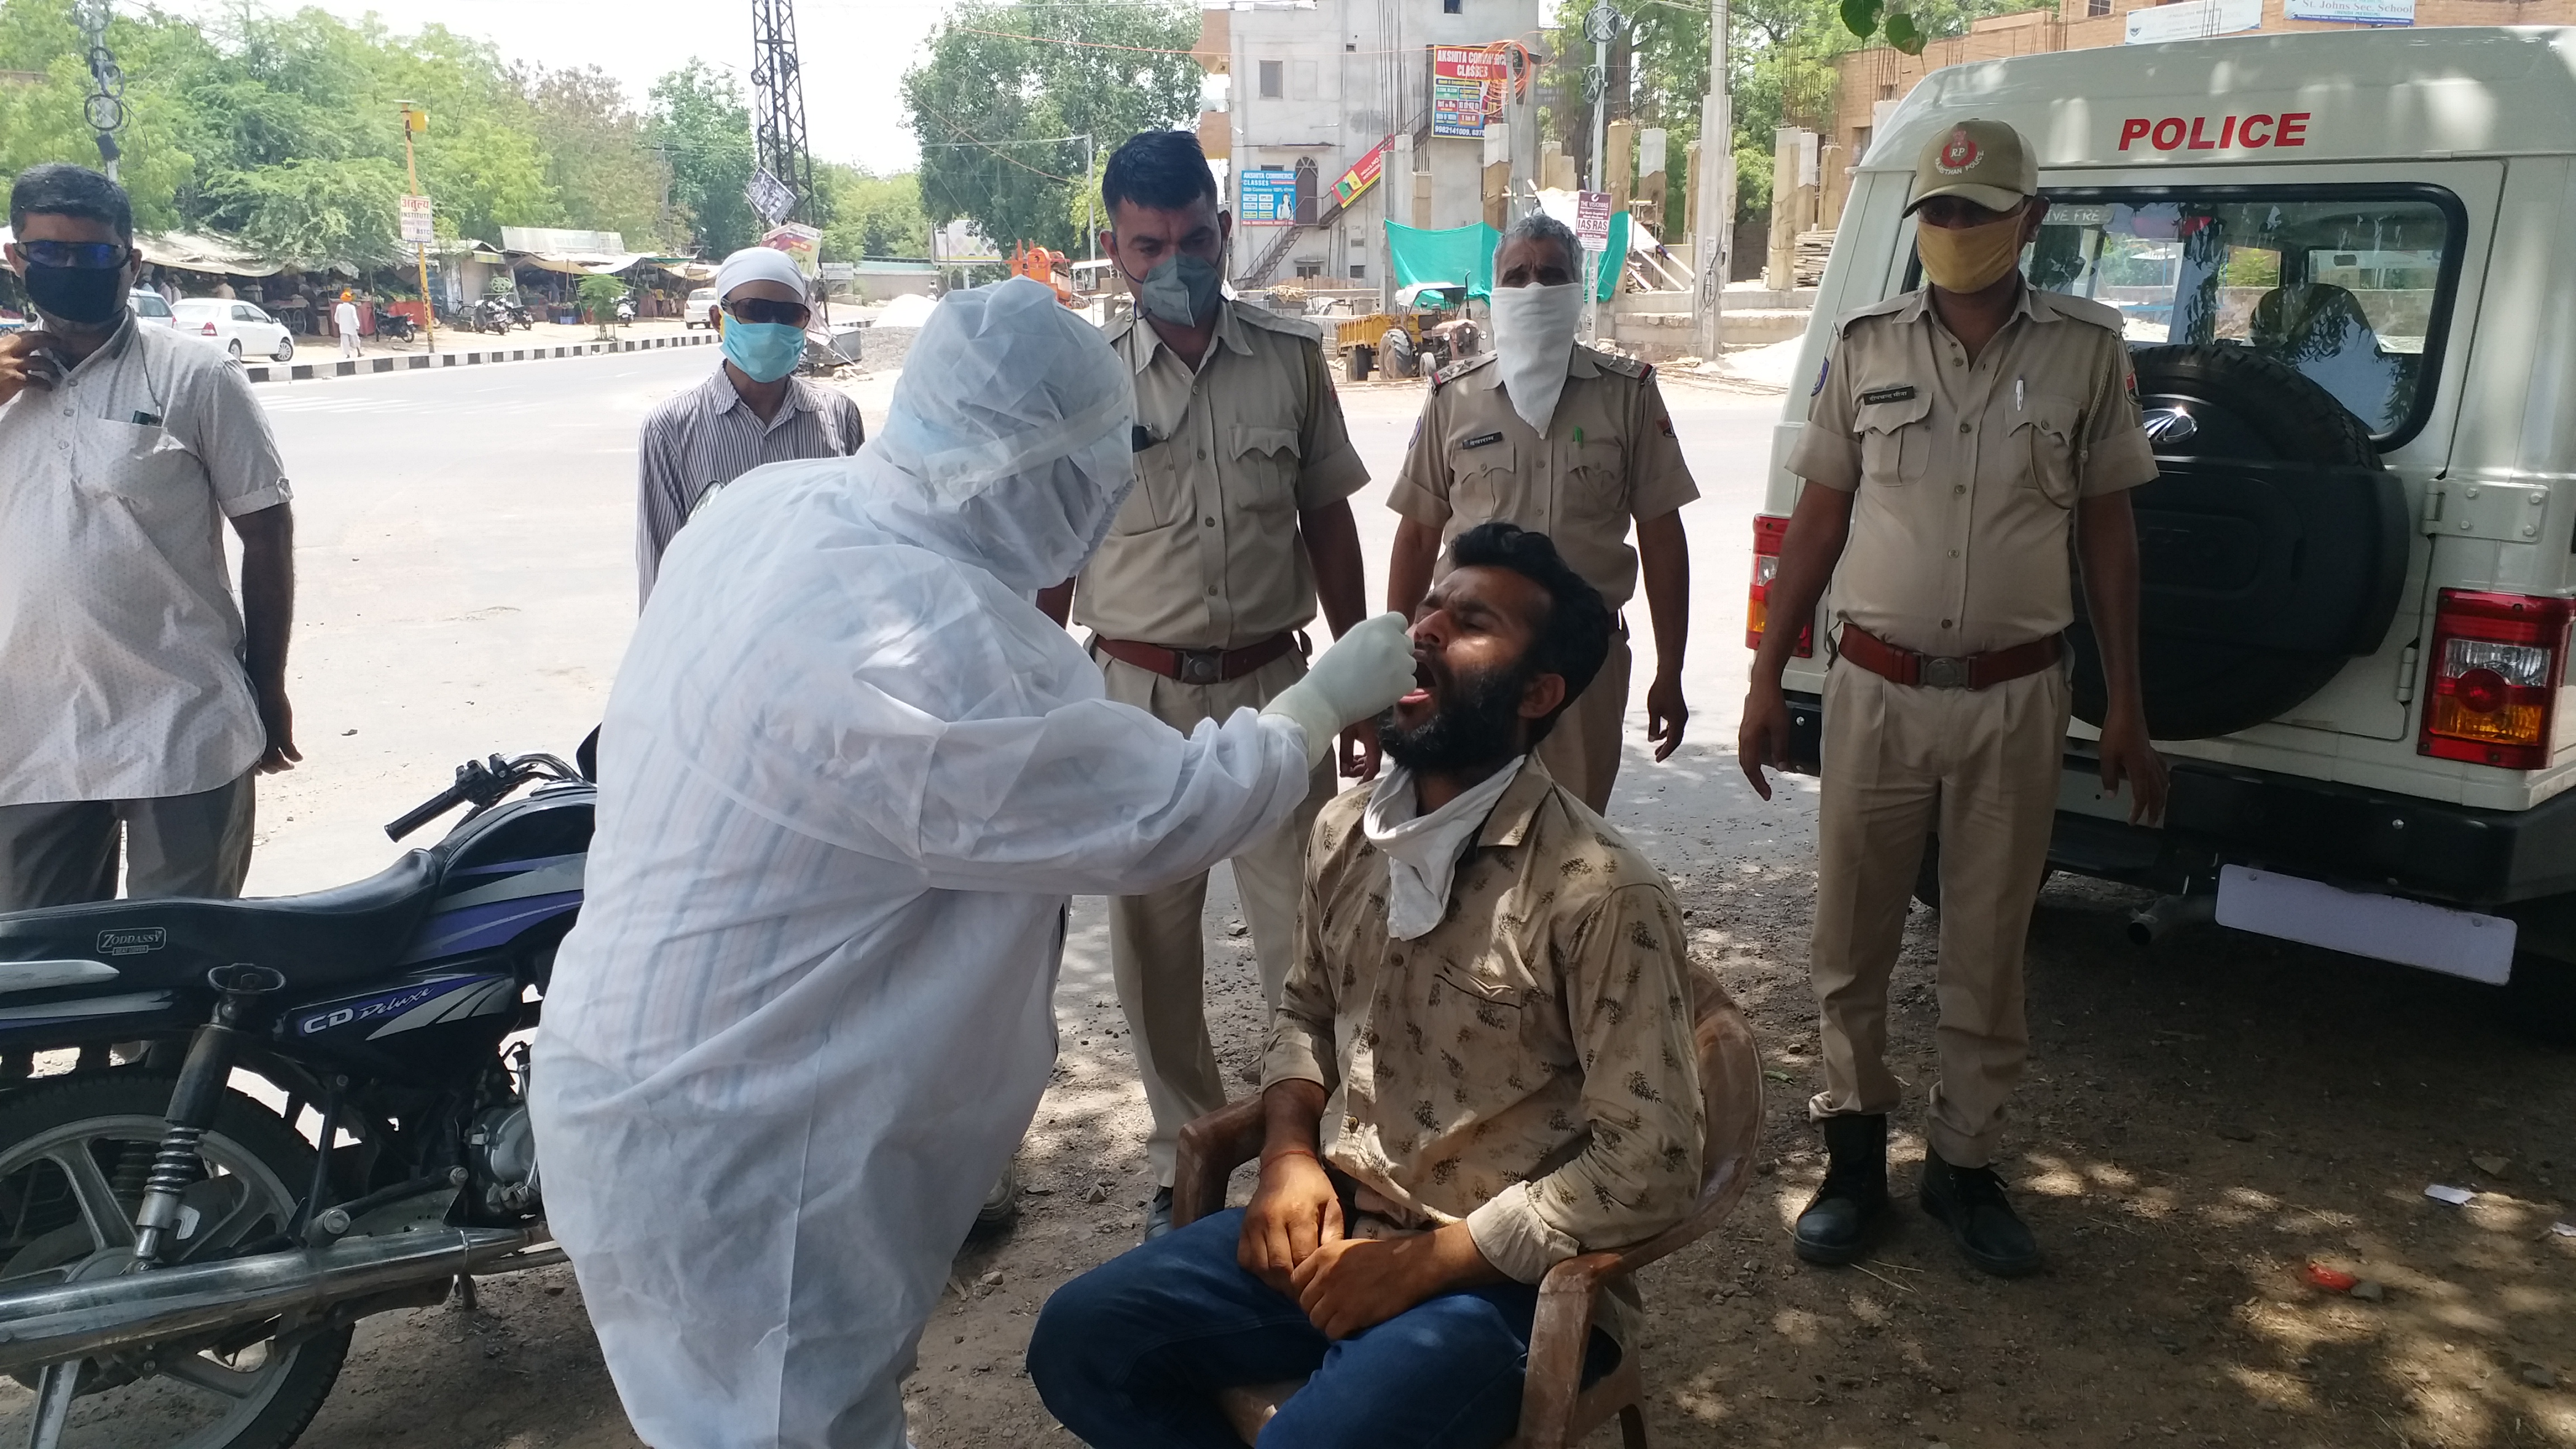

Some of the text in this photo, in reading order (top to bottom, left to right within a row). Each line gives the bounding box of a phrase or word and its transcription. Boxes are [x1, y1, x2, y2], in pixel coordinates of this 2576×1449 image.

[2319, 1, 2350, 10] Johns
[2355, 2, 2374, 12] Sec.
[2378, 4, 2412, 13] School
[1437, 50, 1467, 63] AKSHITA
[1457, 64, 1488, 77] CLASSES
[1435, 126, 1471, 136] 9982141009,
[2118, 112, 2311, 151] POLICE
[1965, 150, 1984, 171] POLICE
[402, 198, 429, 211] अतुल्य
[2042, 210, 2068, 222] IVE
[1578, 219, 1607, 231] IAS RAS
[304, 987, 435, 1034] CD Deluxe
